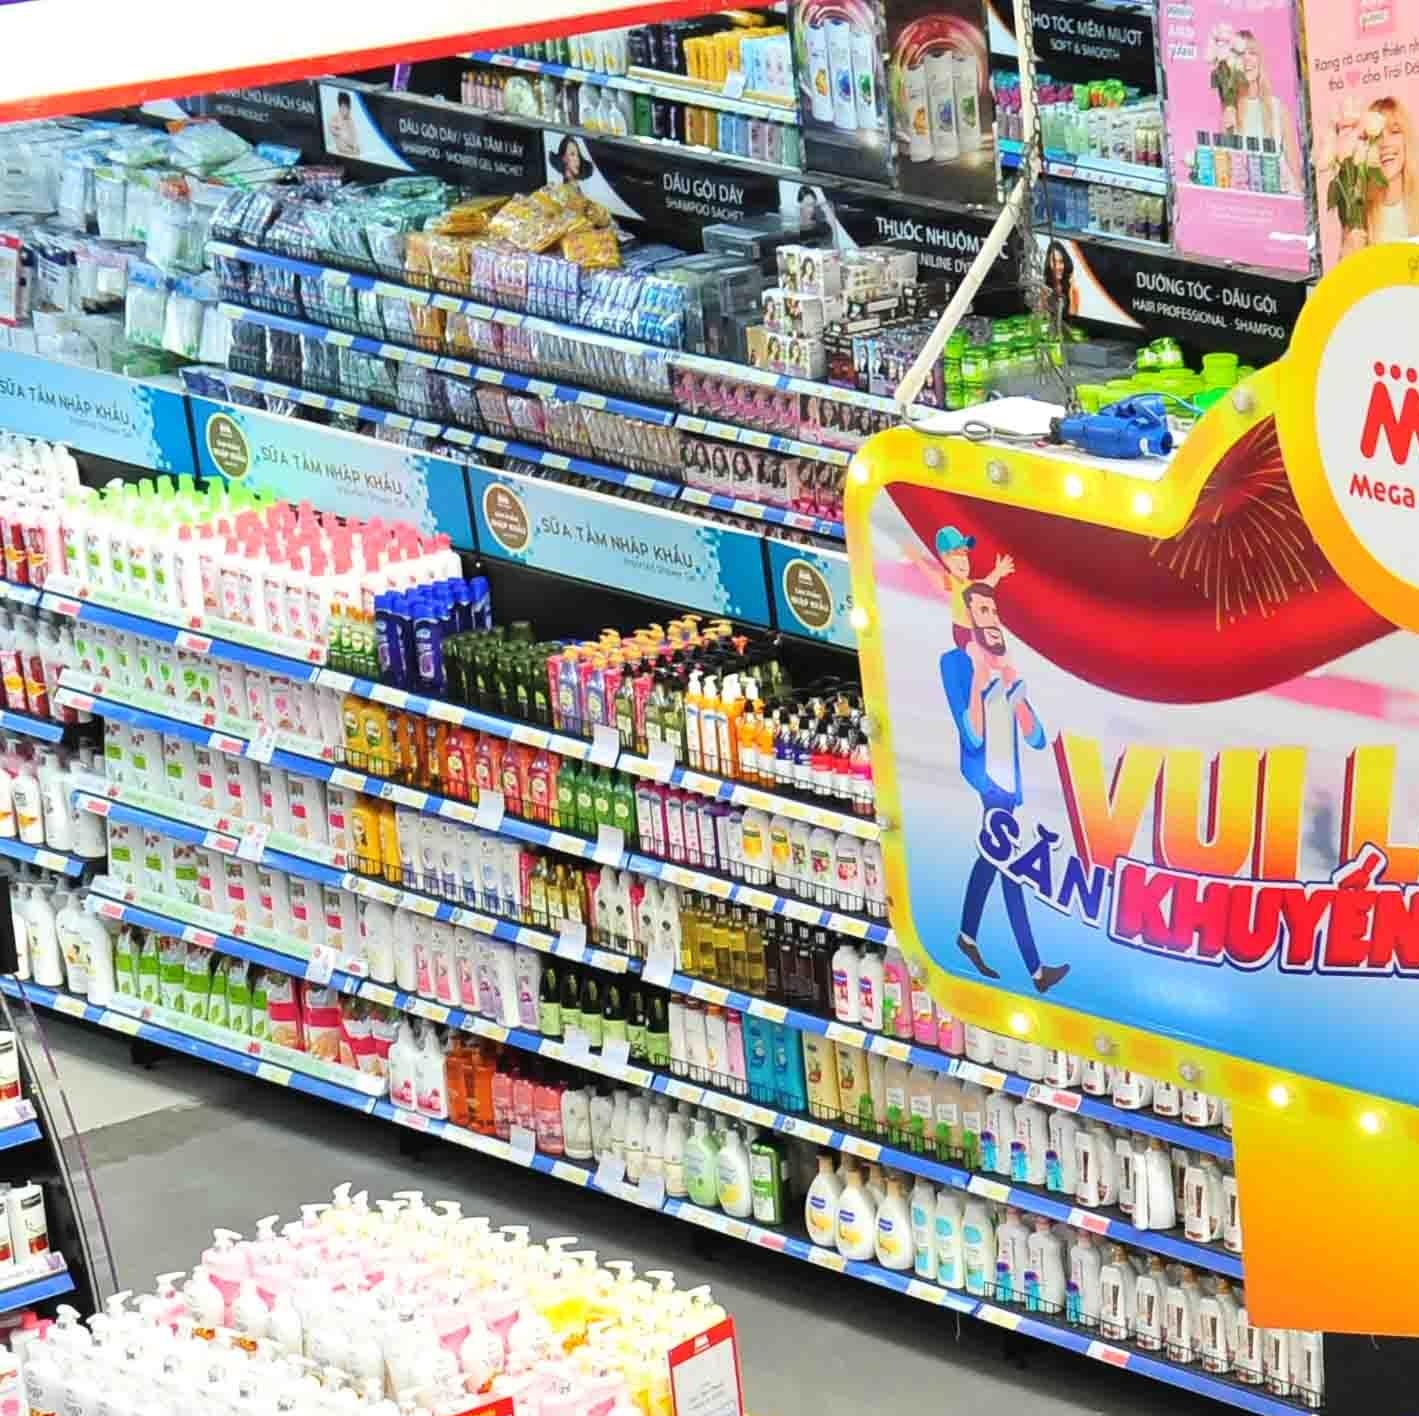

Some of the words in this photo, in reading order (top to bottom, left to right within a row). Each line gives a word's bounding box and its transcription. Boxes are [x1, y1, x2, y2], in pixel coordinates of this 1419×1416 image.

[663, 172, 691, 196] DẦU
[692, 178, 717, 201] GỘI
[718, 183, 745, 207] DÂY
[876, 215, 924, 242] THUỐC
[925, 225, 980, 254] NHUỘM
[1135, 269, 1185, 297] DƯỠNG
[1186, 279, 1214, 303] TÓC
[1222, 286, 1250, 310] DẦU
[1252, 290, 1278, 316] GỘI
[1132, 298, 1155, 315] HAIR
[1155, 301, 1228, 328] PROFESSIONAL
[1234, 316, 1286, 340] SHAMPOO
[1348, 470, 1418, 511] Mega
[1053, 729, 1308, 880] VUI
[979, 808, 1105, 922] SĂN
